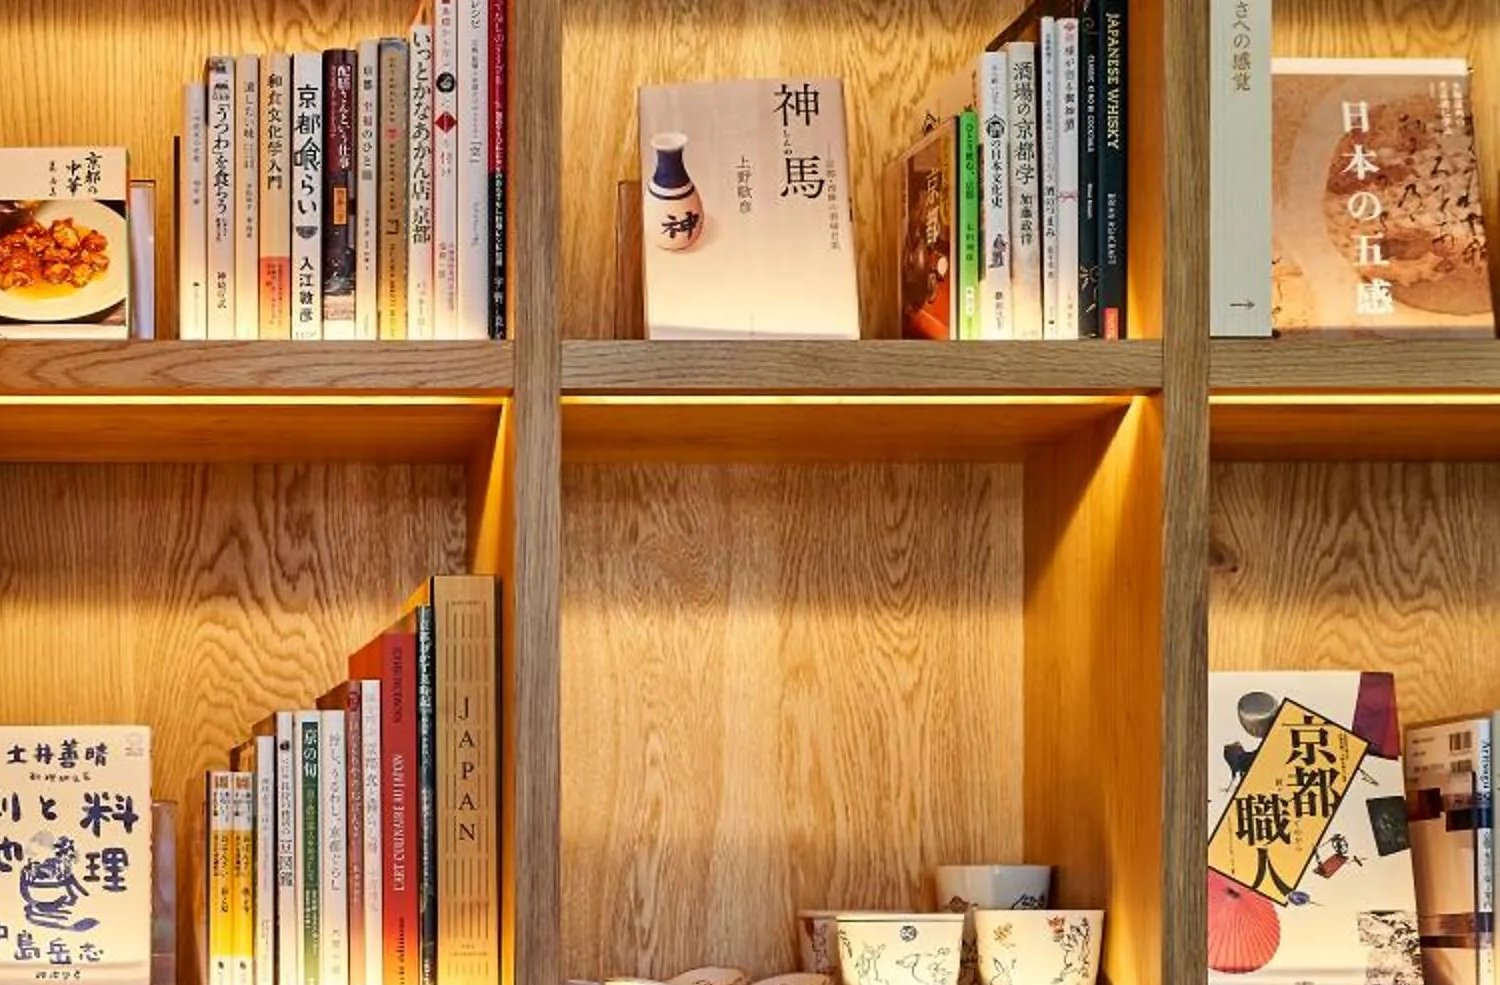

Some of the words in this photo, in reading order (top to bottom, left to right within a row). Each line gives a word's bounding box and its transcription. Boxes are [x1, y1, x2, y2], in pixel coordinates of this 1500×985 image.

[1105, 13, 1121, 84] JAPANESE
[267, 74, 283, 190] 和食文化学入門
[292, 84, 321, 214] 京都喰らい
[773, 83, 825, 199] 神馬
[1012, 61, 1036, 185] 酒場の京都学
[1105, 88, 1121, 149] WHISKY
[85, 152, 103, 194] 京都の
[661, 210, 701, 240] 神
[1341, 100, 1395, 315] 日本の五感
[7, 738, 109, 768] 土井善晴
[458, 696, 476, 841] JAPAN
[1281, 715, 1343, 819] 京都
[40, 795, 58, 821] と
[1235, 793, 1298, 897] 職人
